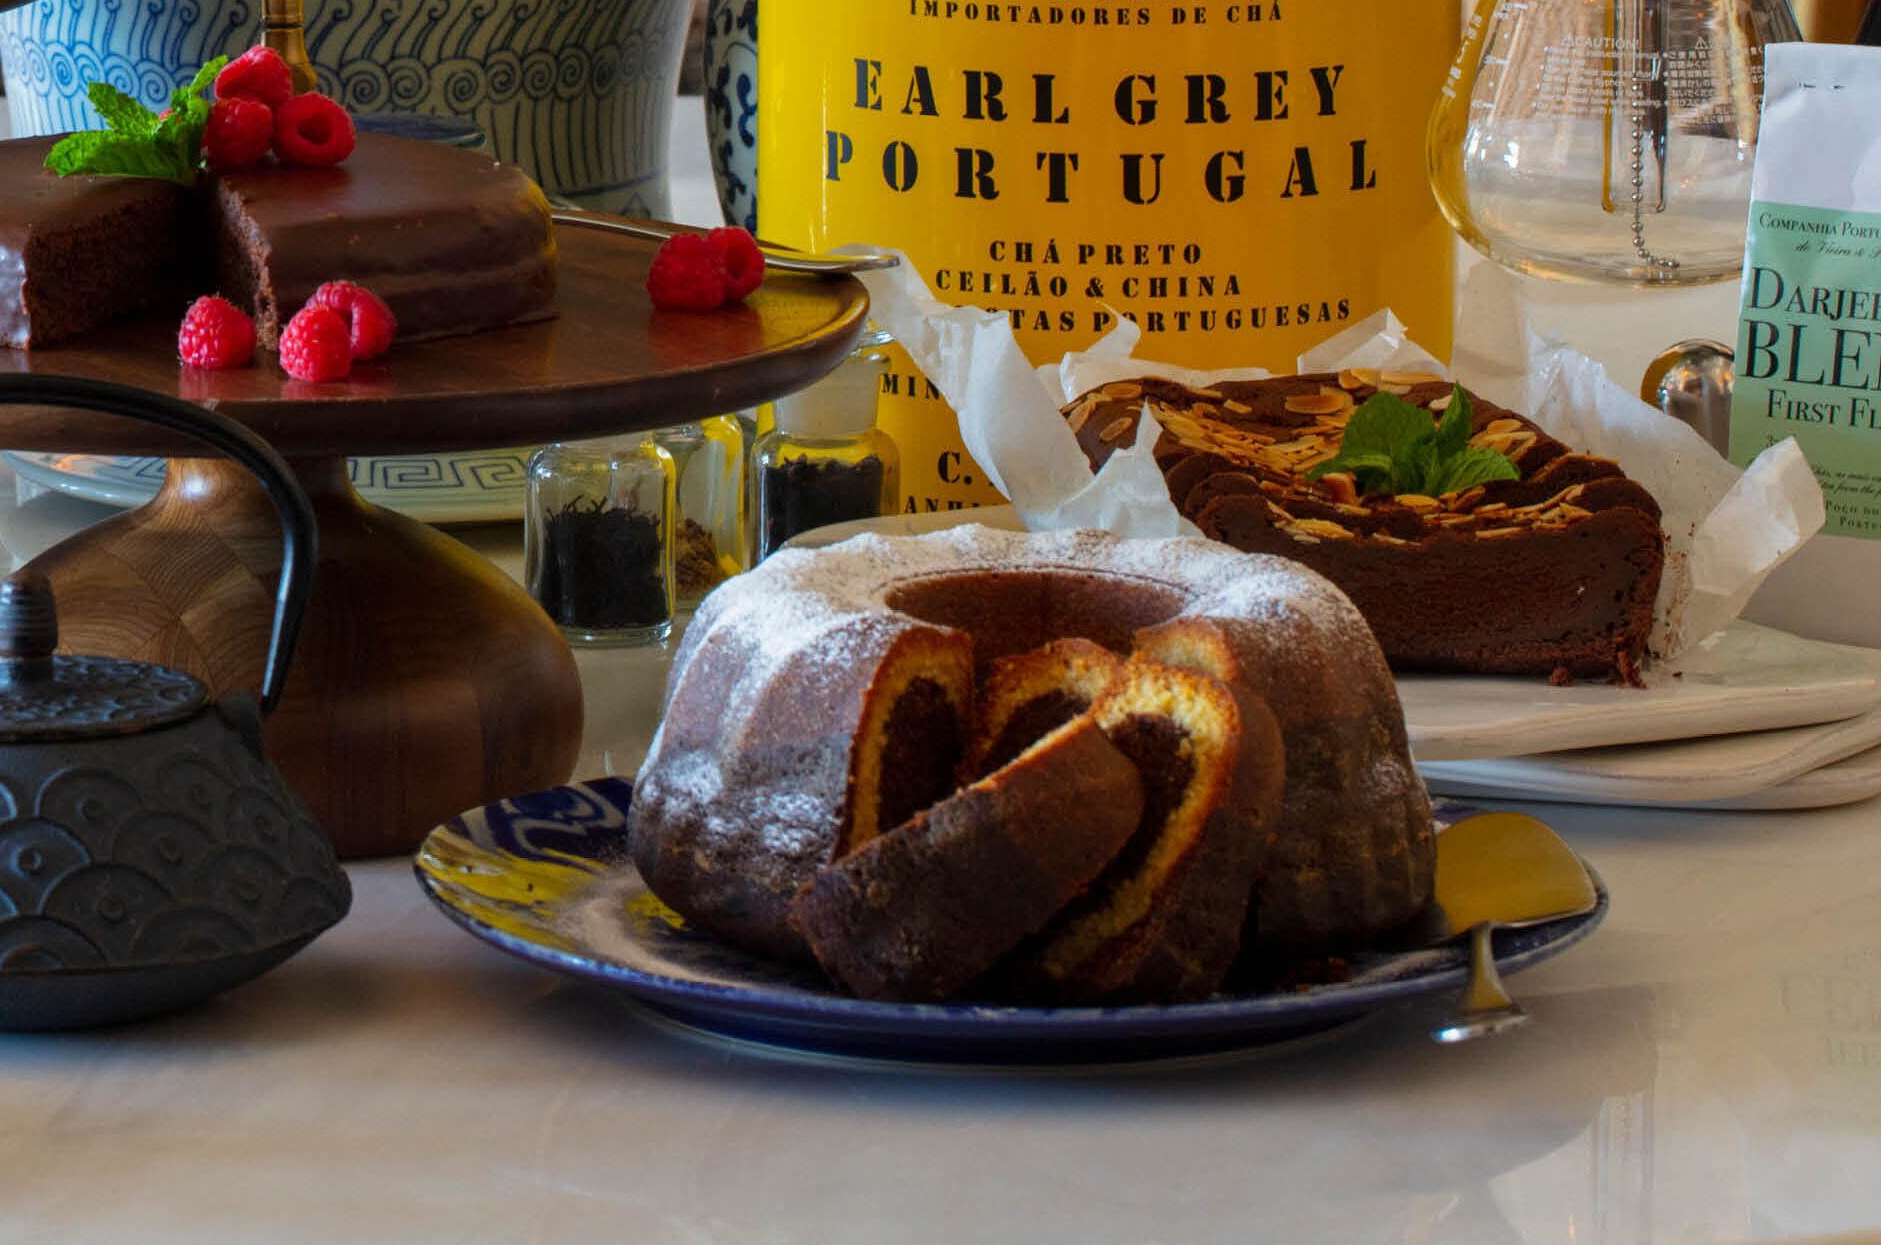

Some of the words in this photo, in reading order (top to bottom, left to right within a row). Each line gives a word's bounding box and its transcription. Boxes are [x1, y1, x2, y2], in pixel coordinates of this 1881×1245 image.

[910, 0, 1151, 25] IMPORTADORES
[1172, 6, 1207, 25] DE
[855, 58, 1071, 124] EARL
[1114, 64, 1345, 127] GREY
[826, 130, 1377, 205] PORTUGAL
[1759, 212, 1837, 236] COMPANHIA
[989, 239, 1061, 265] CHÁ
[1079, 243, 1202, 266] PRETO
[936, 269, 1068, 298] CEILÃO
[1085, 277, 1105, 298] &
[1122, 274, 1241, 299] CHINA
[1738, 319, 1881, 391] BLE
[1766, 388, 1840, 424] FIRST
